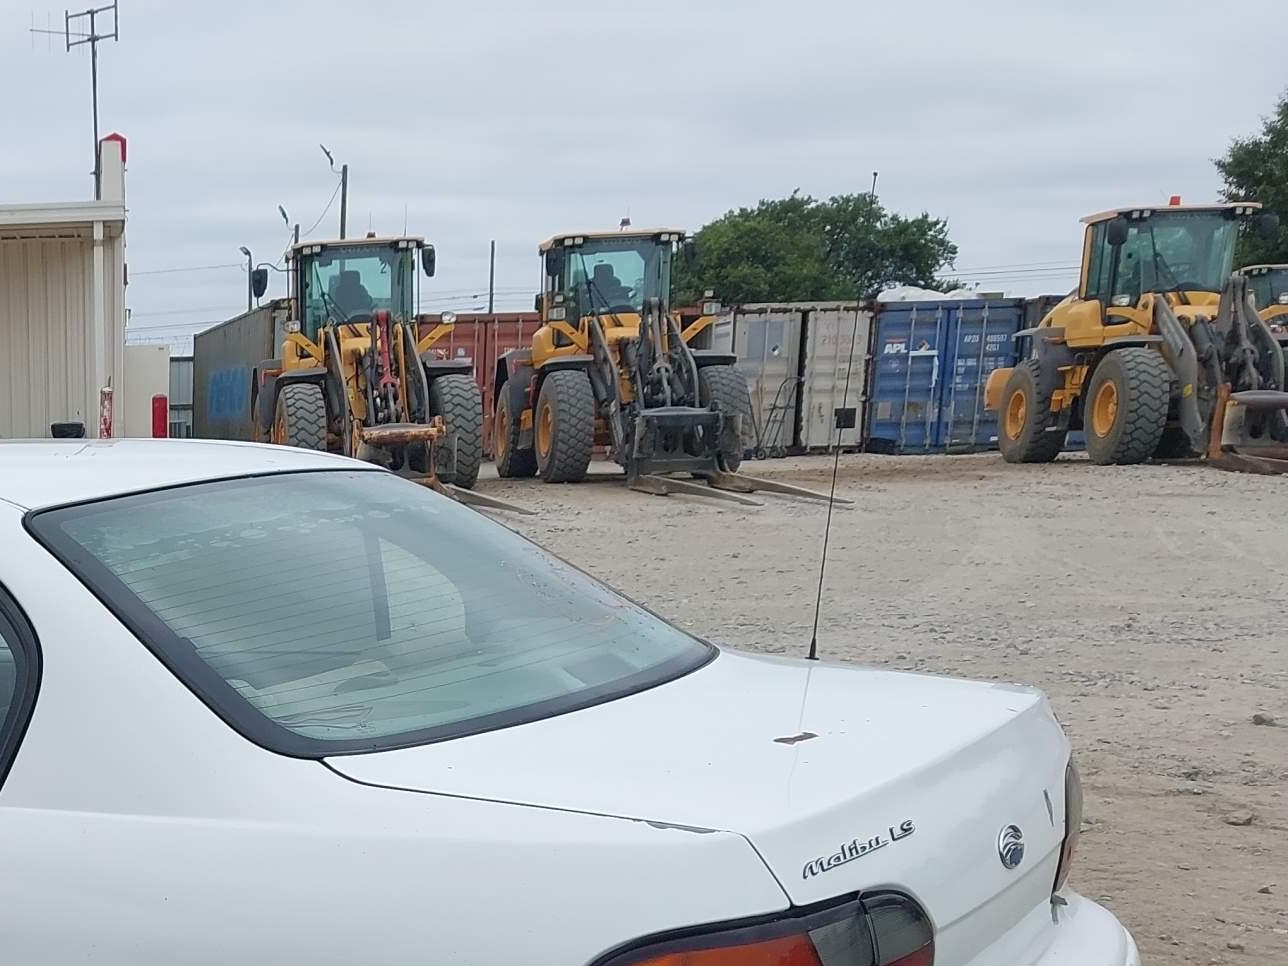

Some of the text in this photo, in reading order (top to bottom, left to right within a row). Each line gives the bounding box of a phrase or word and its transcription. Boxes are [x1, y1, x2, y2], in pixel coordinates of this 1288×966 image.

[884, 343, 908, 354] APL
[802, 819, 915, 880] Malibu LS
